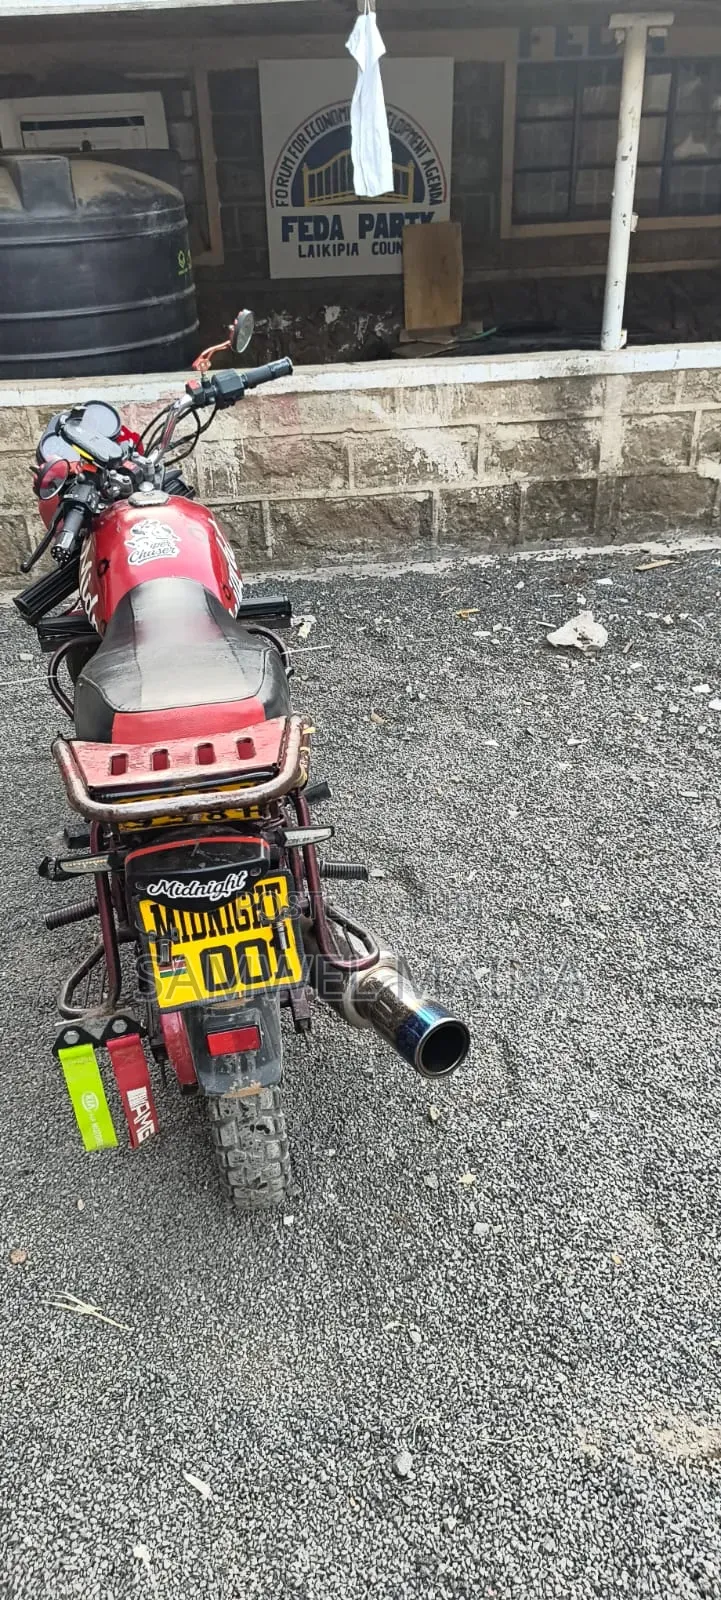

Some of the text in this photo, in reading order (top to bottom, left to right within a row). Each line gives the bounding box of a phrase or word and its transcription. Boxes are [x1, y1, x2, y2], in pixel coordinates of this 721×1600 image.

[517, 25, 664, 58] FED
[275, 106, 443, 208] FORUM FOR ECONOM LOPMENT AGENDA
[281, 214, 345, 242] FEDA
[298, 241, 404, 258] LAIKIPIA COUN
[147, 871, 249, 901] Midnight
[150, 882, 282, 945] MIDNIGHT
[199, 922, 294, 993] 001
